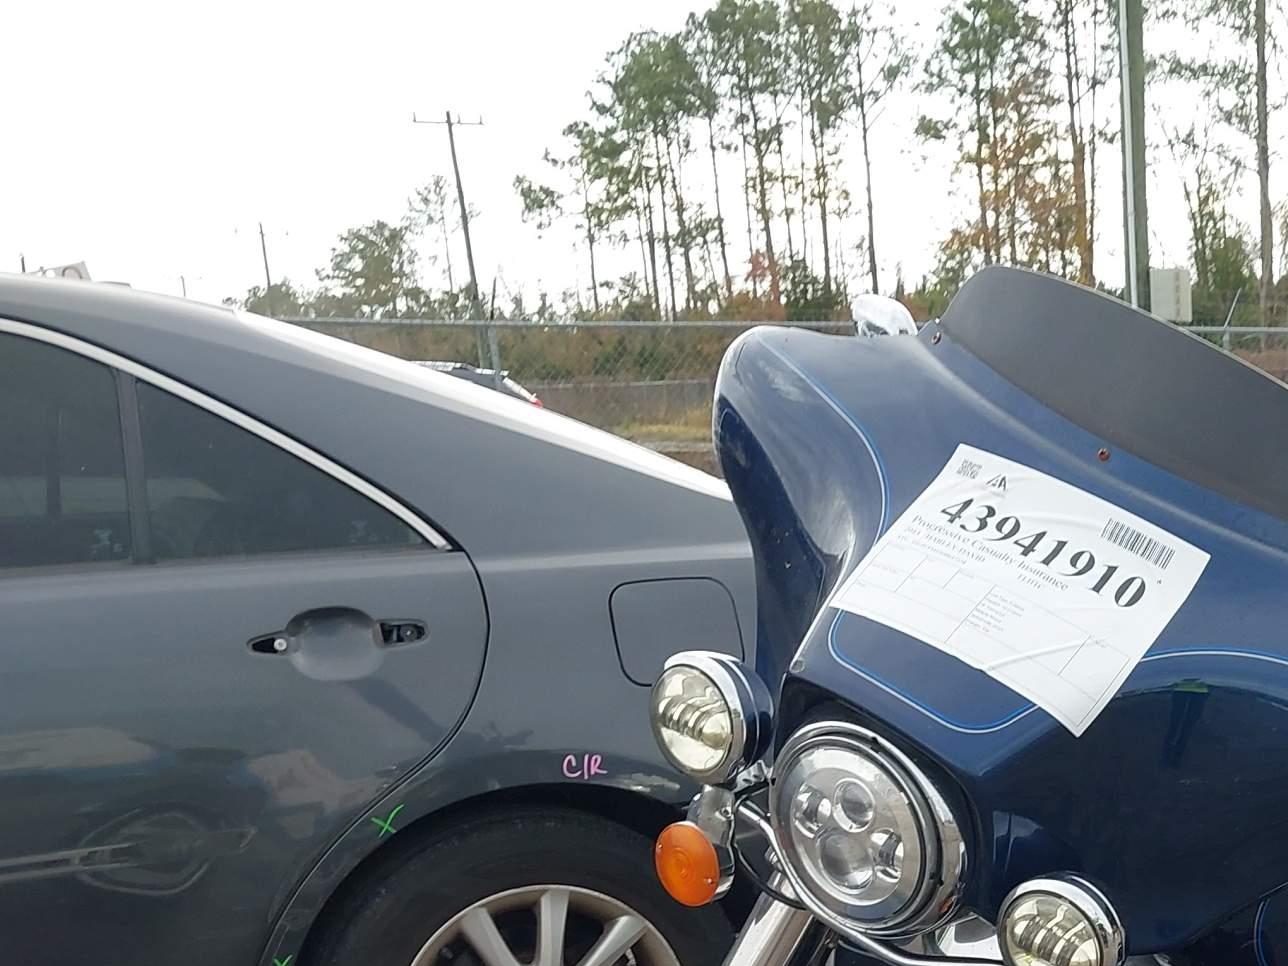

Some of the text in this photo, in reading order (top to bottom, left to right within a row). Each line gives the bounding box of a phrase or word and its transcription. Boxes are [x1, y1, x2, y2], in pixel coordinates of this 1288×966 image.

[911, 515, 971, 543] Progressive
[971, 539, 1017, 565] Casualty
[1017, 560, 1068, 591] Insurance
[940, 498, 1146, 607] 43941910
